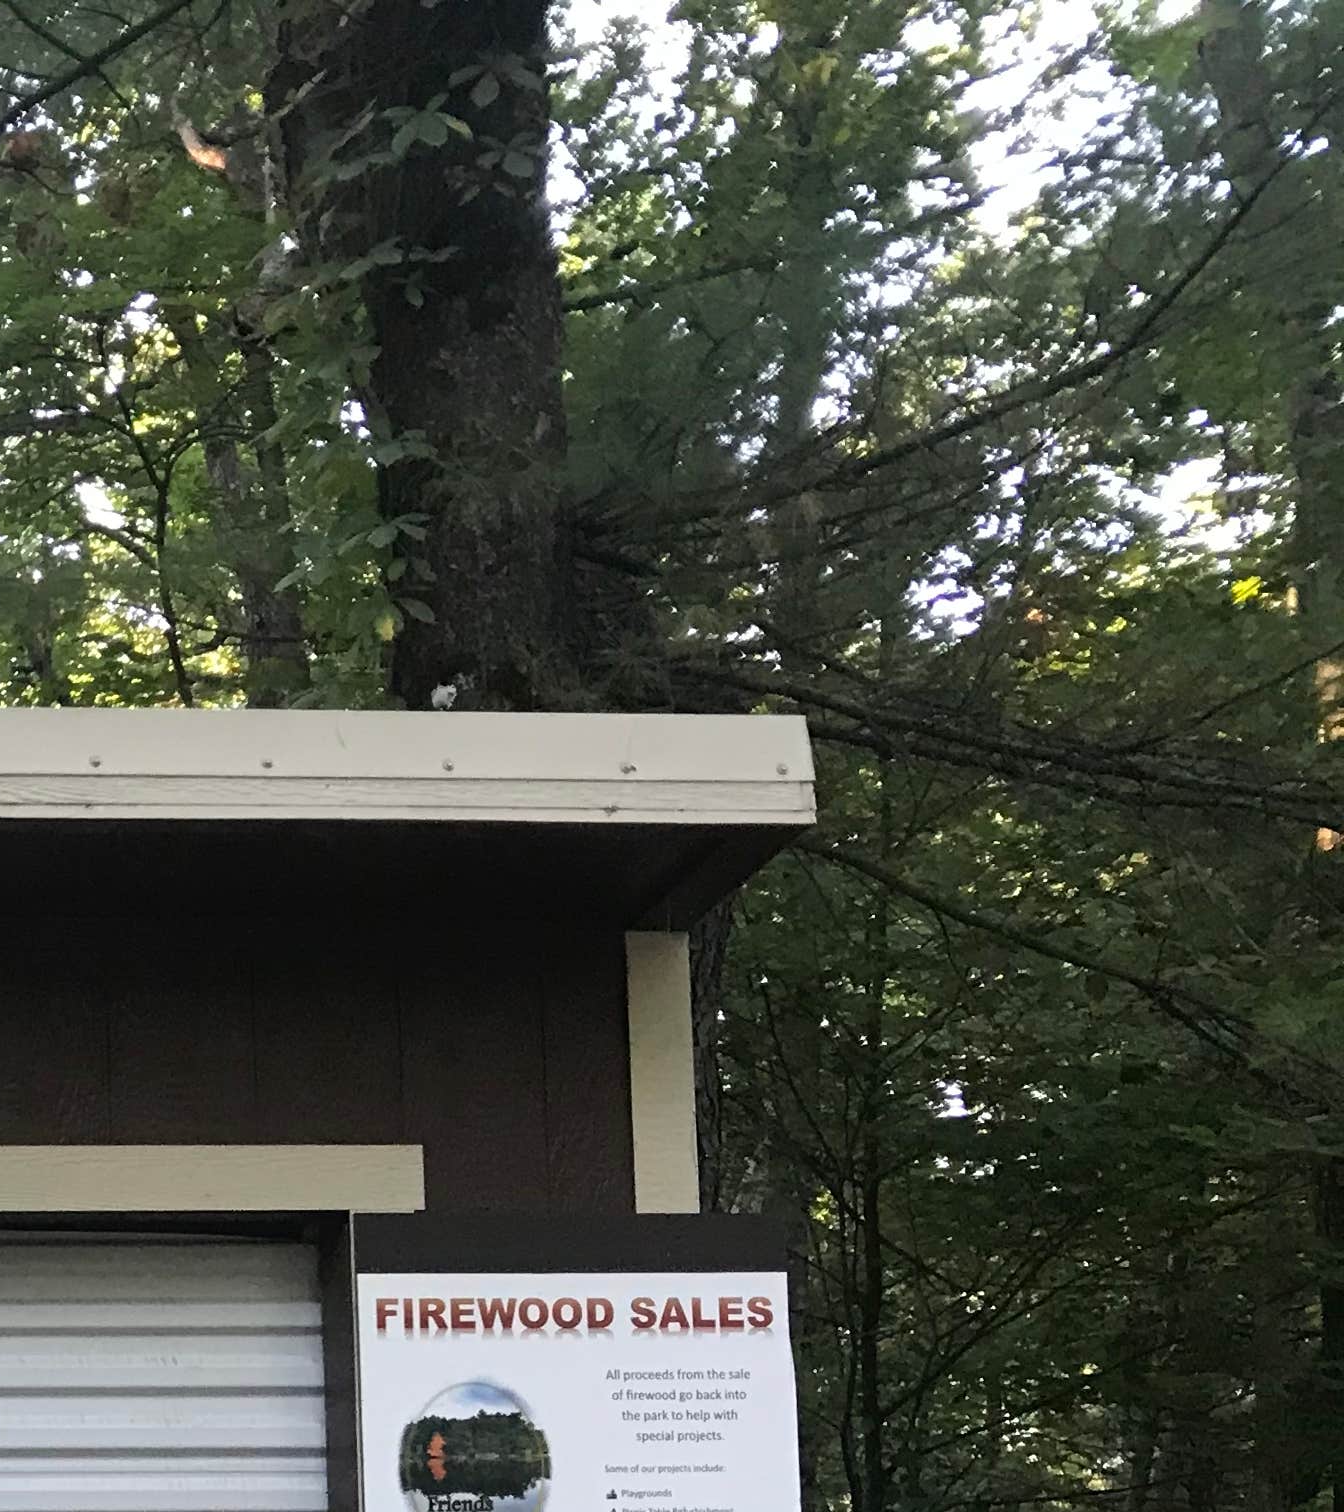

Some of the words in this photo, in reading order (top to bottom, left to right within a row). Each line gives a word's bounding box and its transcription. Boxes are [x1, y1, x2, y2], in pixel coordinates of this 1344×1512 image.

[375, 1297, 614, 1331] FIREWOOD
[630, 1296, 774, 1330] SALES
[605, 1369, 620, 1380] All
[623, 1369, 674, 1382] proceeds
[677, 1369, 704, 1380] from
[707, 1369, 725, 1380] the
[728, 1368, 751, 1380] sale
[612, 1389, 623, 1400] of
[626, 1389, 676, 1400] firewood
[679, 1392, 693, 1402] go
[696, 1389, 721, 1400] back
[724, 1389, 747, 1400] into
[622, 1410, 640, 1421] the
[643, 1410, 669, 1422] park
[671, 1411, 683, 1421] to
[686, 1410, 711, 1422] help
[714, 1410, 738, 1420] with
[636, 1431, 674, 1443] special
[604, 1464, 628, 1473] Some
[630, 1464, 640, 1473] of
[641, 1465, 655, 1473] our
[658, 1464, 692, 1474] projects
[621, 1489, 672, 1499] Playgrounds
[428, 1495, 494, 1512] Friends
